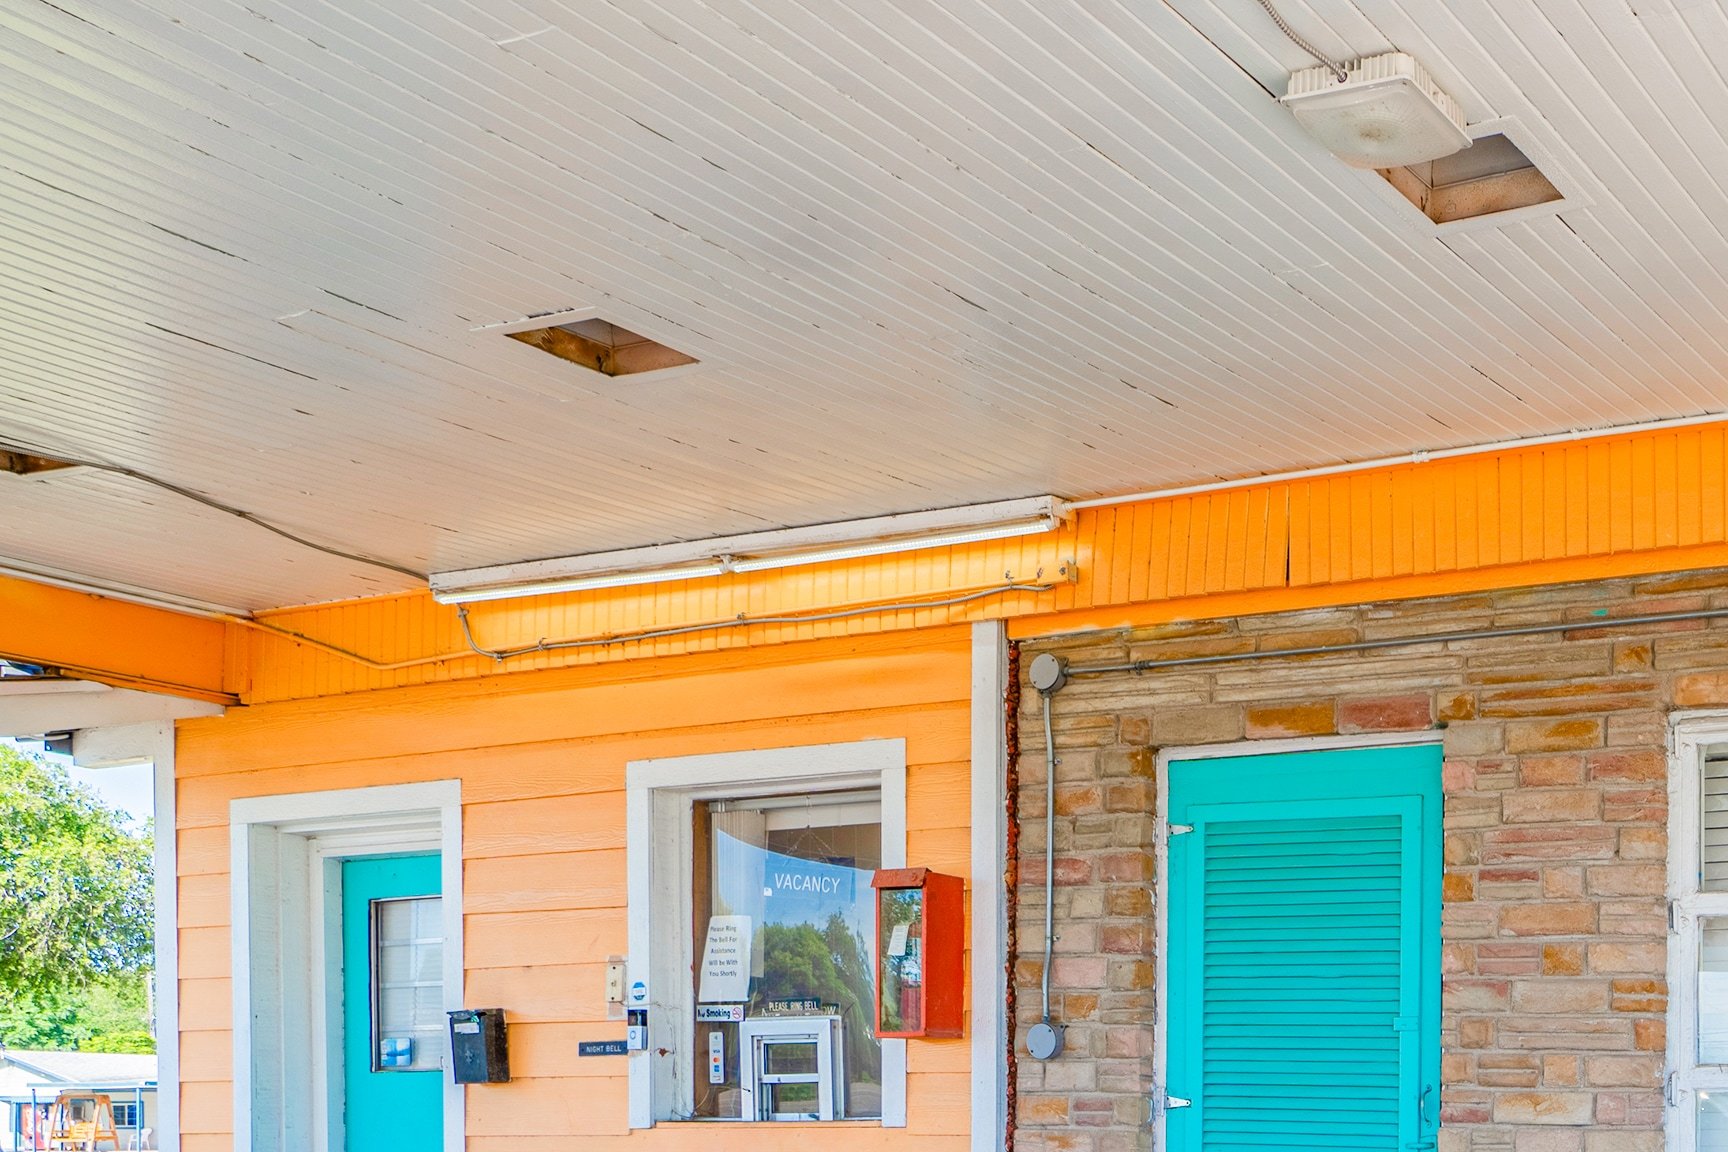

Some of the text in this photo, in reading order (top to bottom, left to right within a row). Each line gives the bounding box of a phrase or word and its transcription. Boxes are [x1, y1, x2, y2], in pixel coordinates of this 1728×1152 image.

[775, 873, 840, 893] VACANCY
[725, 925, 737, 933] Ring
[768, 1001, 789, 1011] PLEASE
[804, 1000, 818, 1011] BELL
[706, 1008, 730, 1019] Smoking
[605, 1044, 621, 1052] BELL
